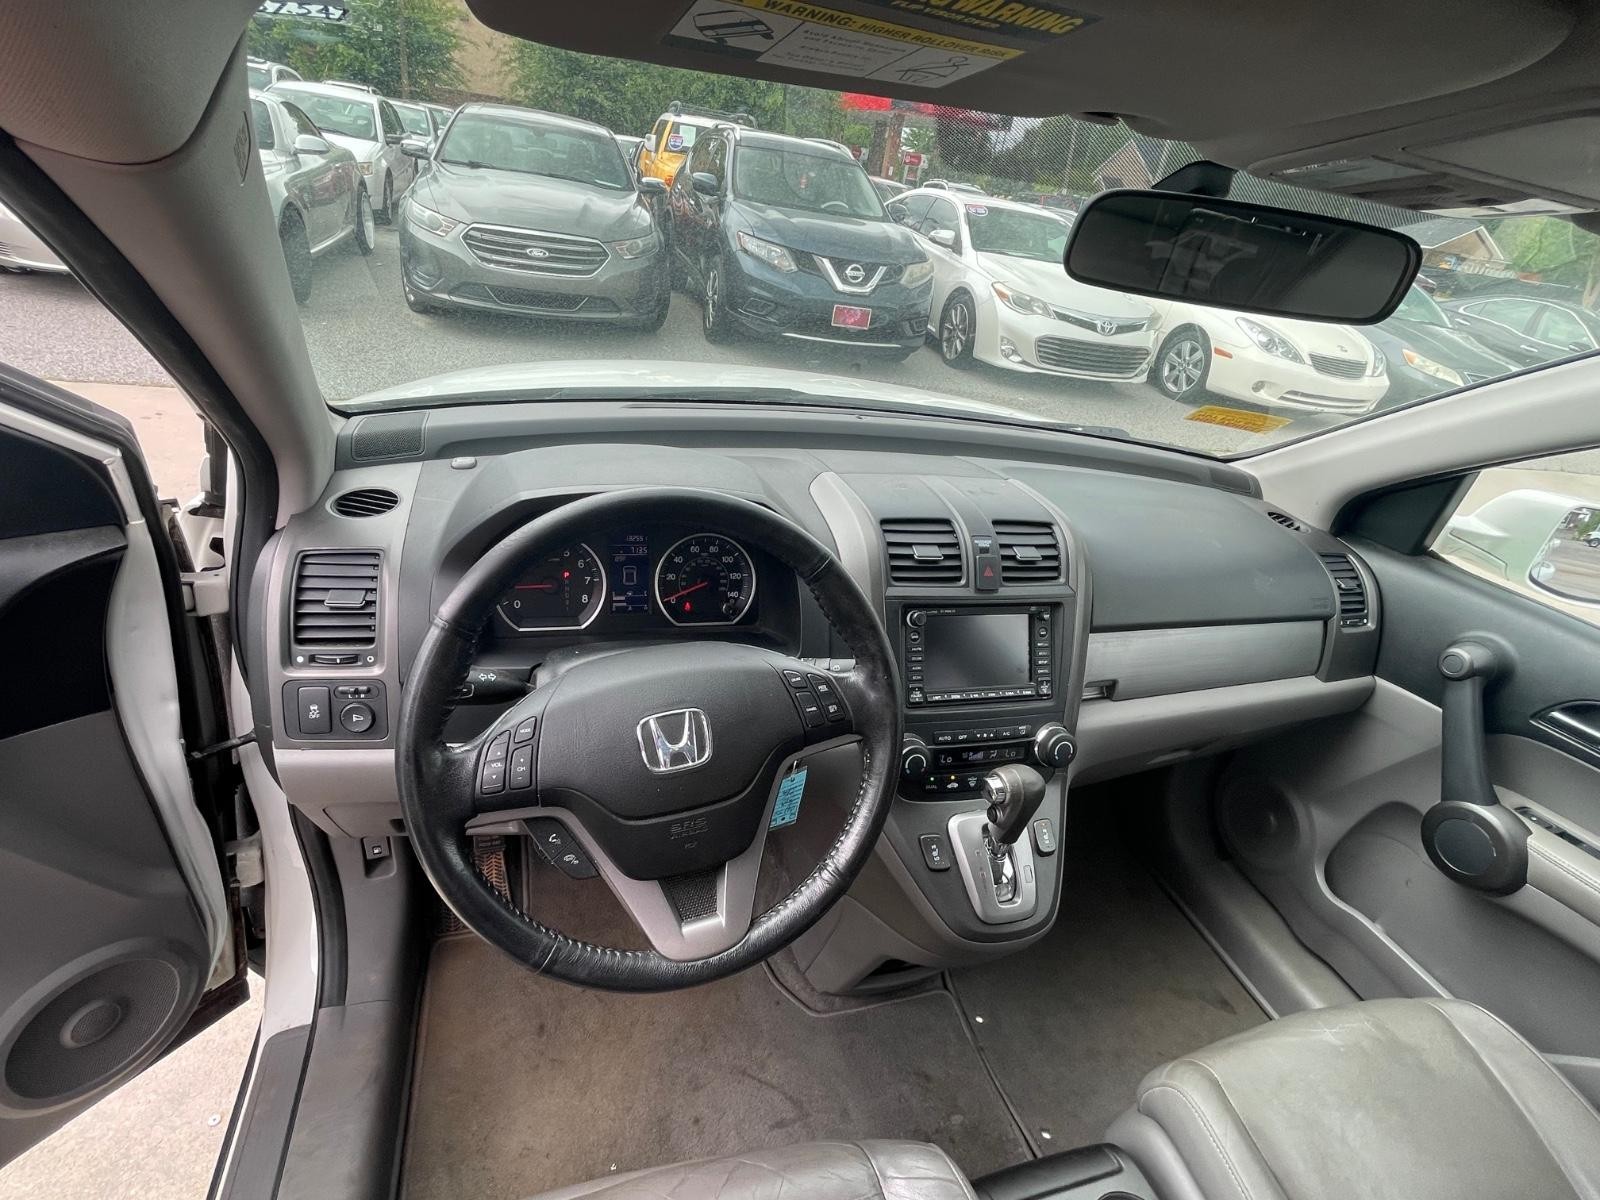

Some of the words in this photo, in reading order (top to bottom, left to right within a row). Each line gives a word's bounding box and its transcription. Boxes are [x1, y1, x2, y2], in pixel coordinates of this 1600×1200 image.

[858, 22, 911, 39] HIGHER
[910, 32, 979, 53] ROLLOVER
[578, 560, 584, 568] 6
[584, 576, 591, 585] 7
[581, 594, 588, 603] 8
[513, 600, 521, 608] 0
